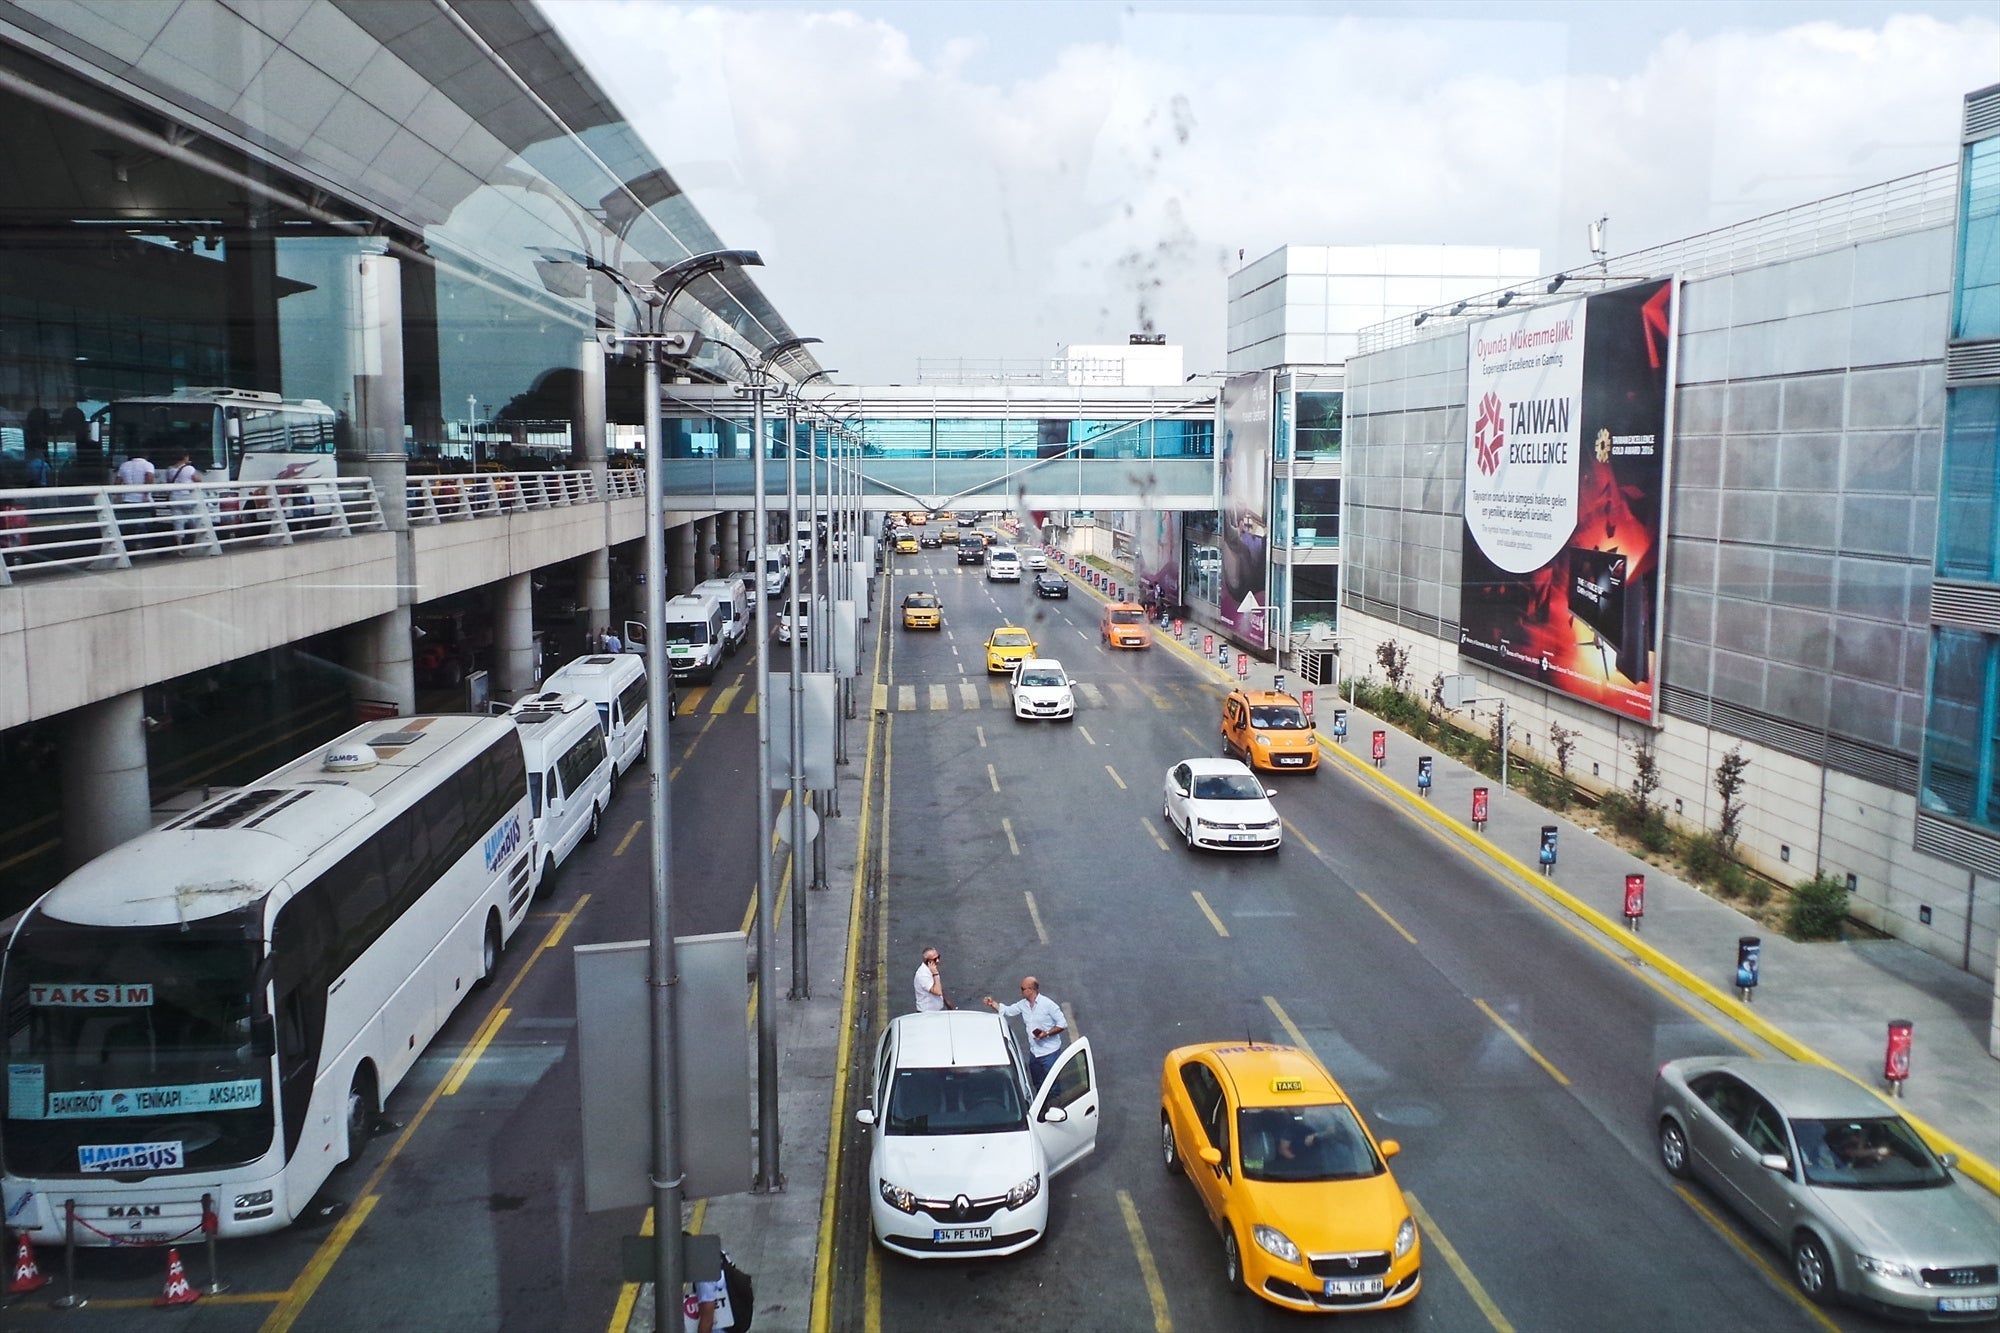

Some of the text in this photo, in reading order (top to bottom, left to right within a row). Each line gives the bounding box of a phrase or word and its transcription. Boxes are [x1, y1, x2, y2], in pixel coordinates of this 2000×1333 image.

[1477, 320, 1574, 361] Oyunda Mükemmellik!
[1482, 352, 1563, 377] Experience Excellence in Gaming
[1509, 397, 1570, 435] TAIWAN
[1510, 443, 1567, 464] EXCELLENCE
[31, 984, 149, 1003] TAKSİM
[53, 1091, 103, 1113] BAKIRKÖY
[135, 1088, 181, 1110] YENİKAPI
[208, 1084, 257, 1105] AKSARAY
[108, 1205, 160, 1217] MAN
[940, 1229, 990, 1240] 34 PE 1487
